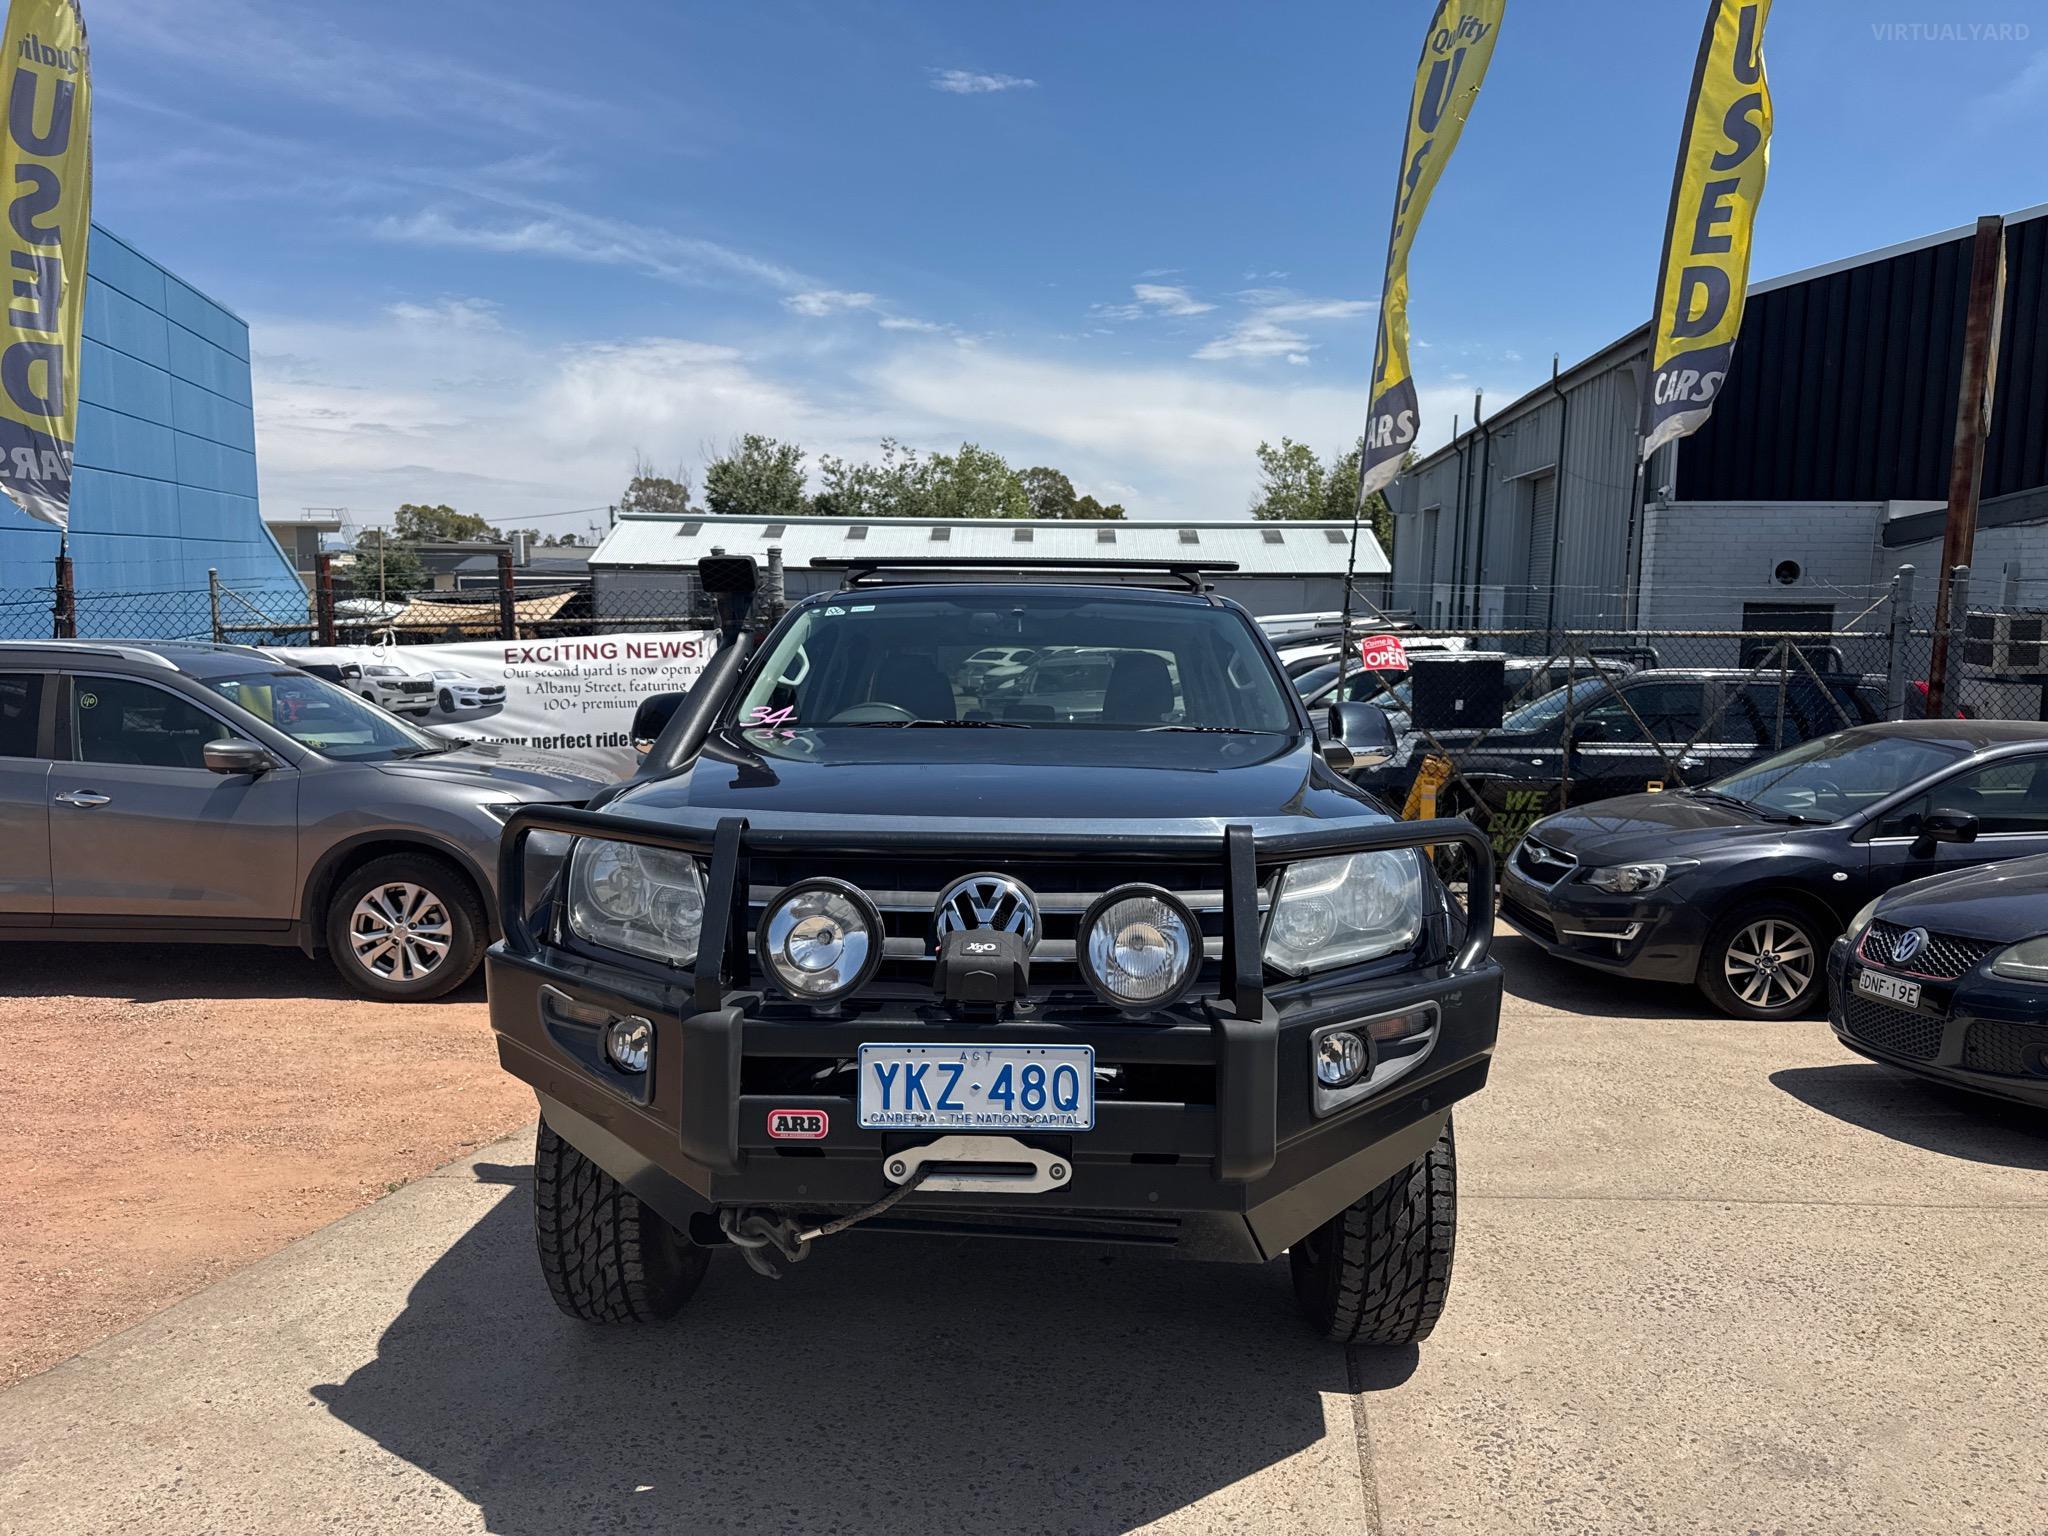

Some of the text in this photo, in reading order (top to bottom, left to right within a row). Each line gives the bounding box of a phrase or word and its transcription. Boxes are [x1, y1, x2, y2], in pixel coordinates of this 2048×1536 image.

[1432, 15, 1492, 55] Qulity
[1671, 4, 1762, 339] USED
[1655, 369, 1723, 405] CARS
[1368, 410, 1414, 450] ARS
[504, 640, 704, 665] EXCITING NEWS!
[1366, 650, 1405, 666] OPEN
[503, 668, 531, 679] Our
[535, 665, 579, 678] second
[584, 664, 613, 680] yard
[617, 663, 627, 676] is
[631, 666, 657, 676] now
[662, 665, 691, 679] open
[535, 681, 581, 695] Albany
[585, 680, 626, 693] Street,
[630, 679, 687, 693] featuring
[544, 697, 638, 713] 100+ premium
[740, 705, 797, 729] 34
[490, 738, 527, 746] our
[532, 733, 593, 749] perfect
[1505, 790, 1548, 811] WE
[775, 1115, 821, 1132] ARB
[871, 1113, 936, 1124] CANBERRA
[950, 1114, 972, 1124] THE
[1034, 1114, 1081, 1125] CAPITAL
